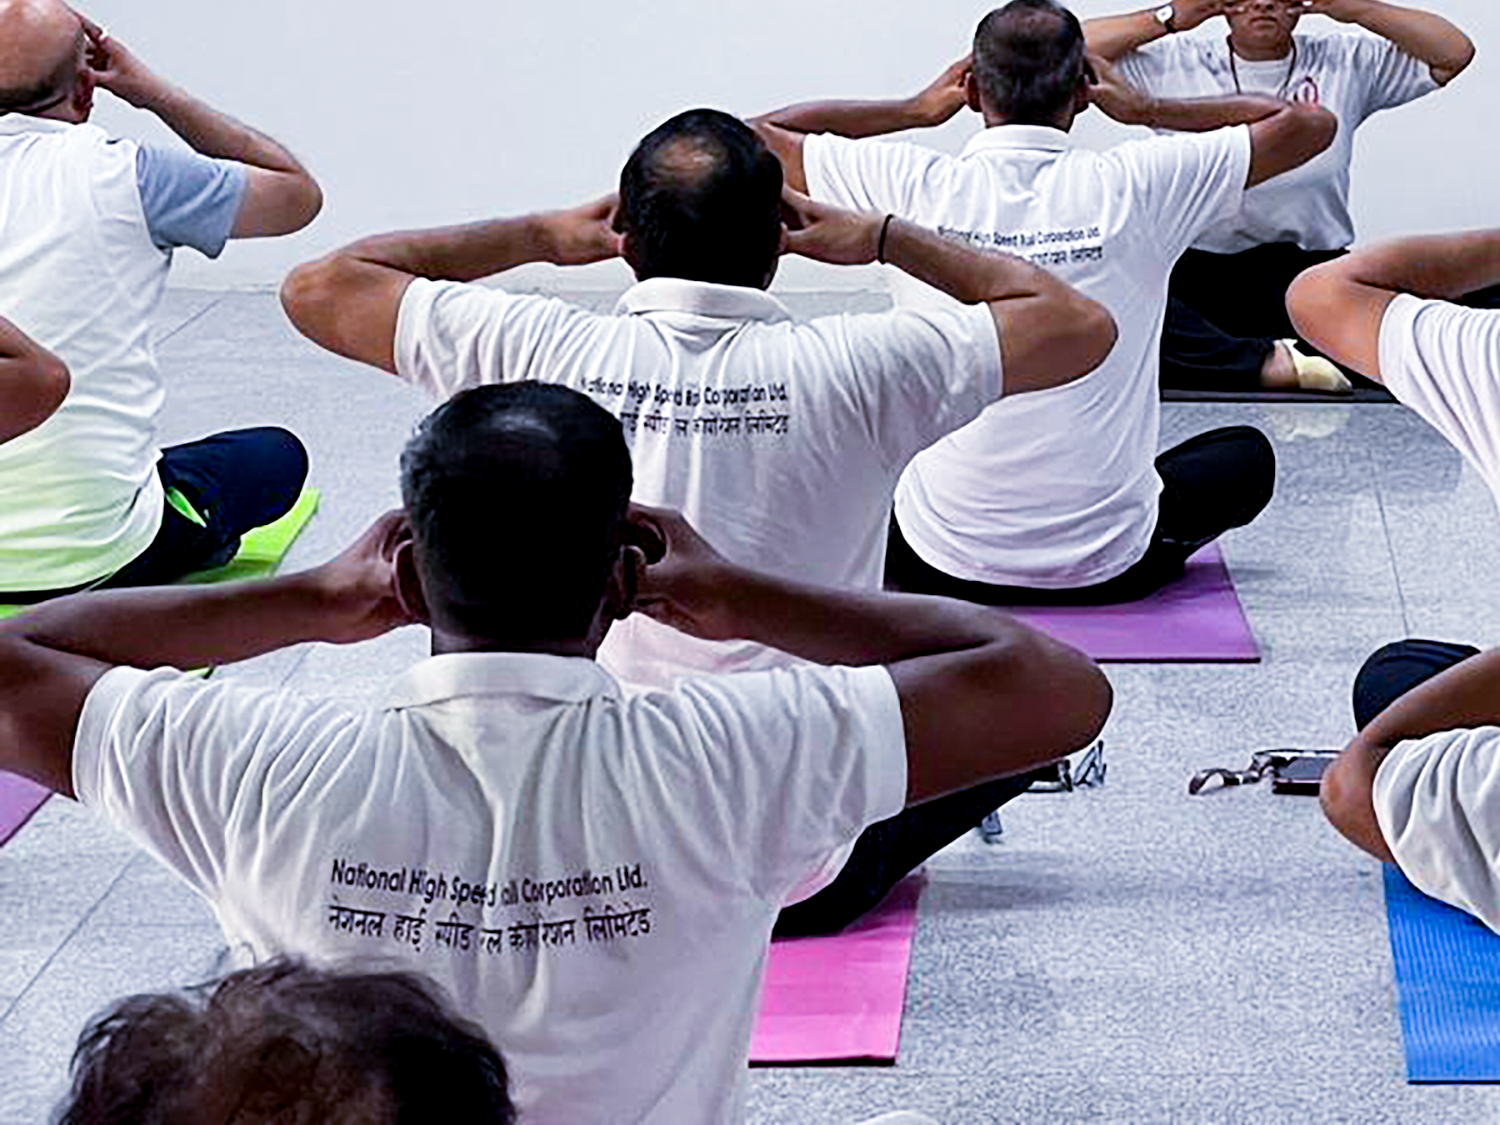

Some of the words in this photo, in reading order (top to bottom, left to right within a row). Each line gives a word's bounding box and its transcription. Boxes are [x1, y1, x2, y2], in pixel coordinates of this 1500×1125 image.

[331, 859, 407, 893] National
[409, 868, 448, 904] High
[521, 869, 614, 906] Corporation
[616, 863, 648, 891] Ltd.
